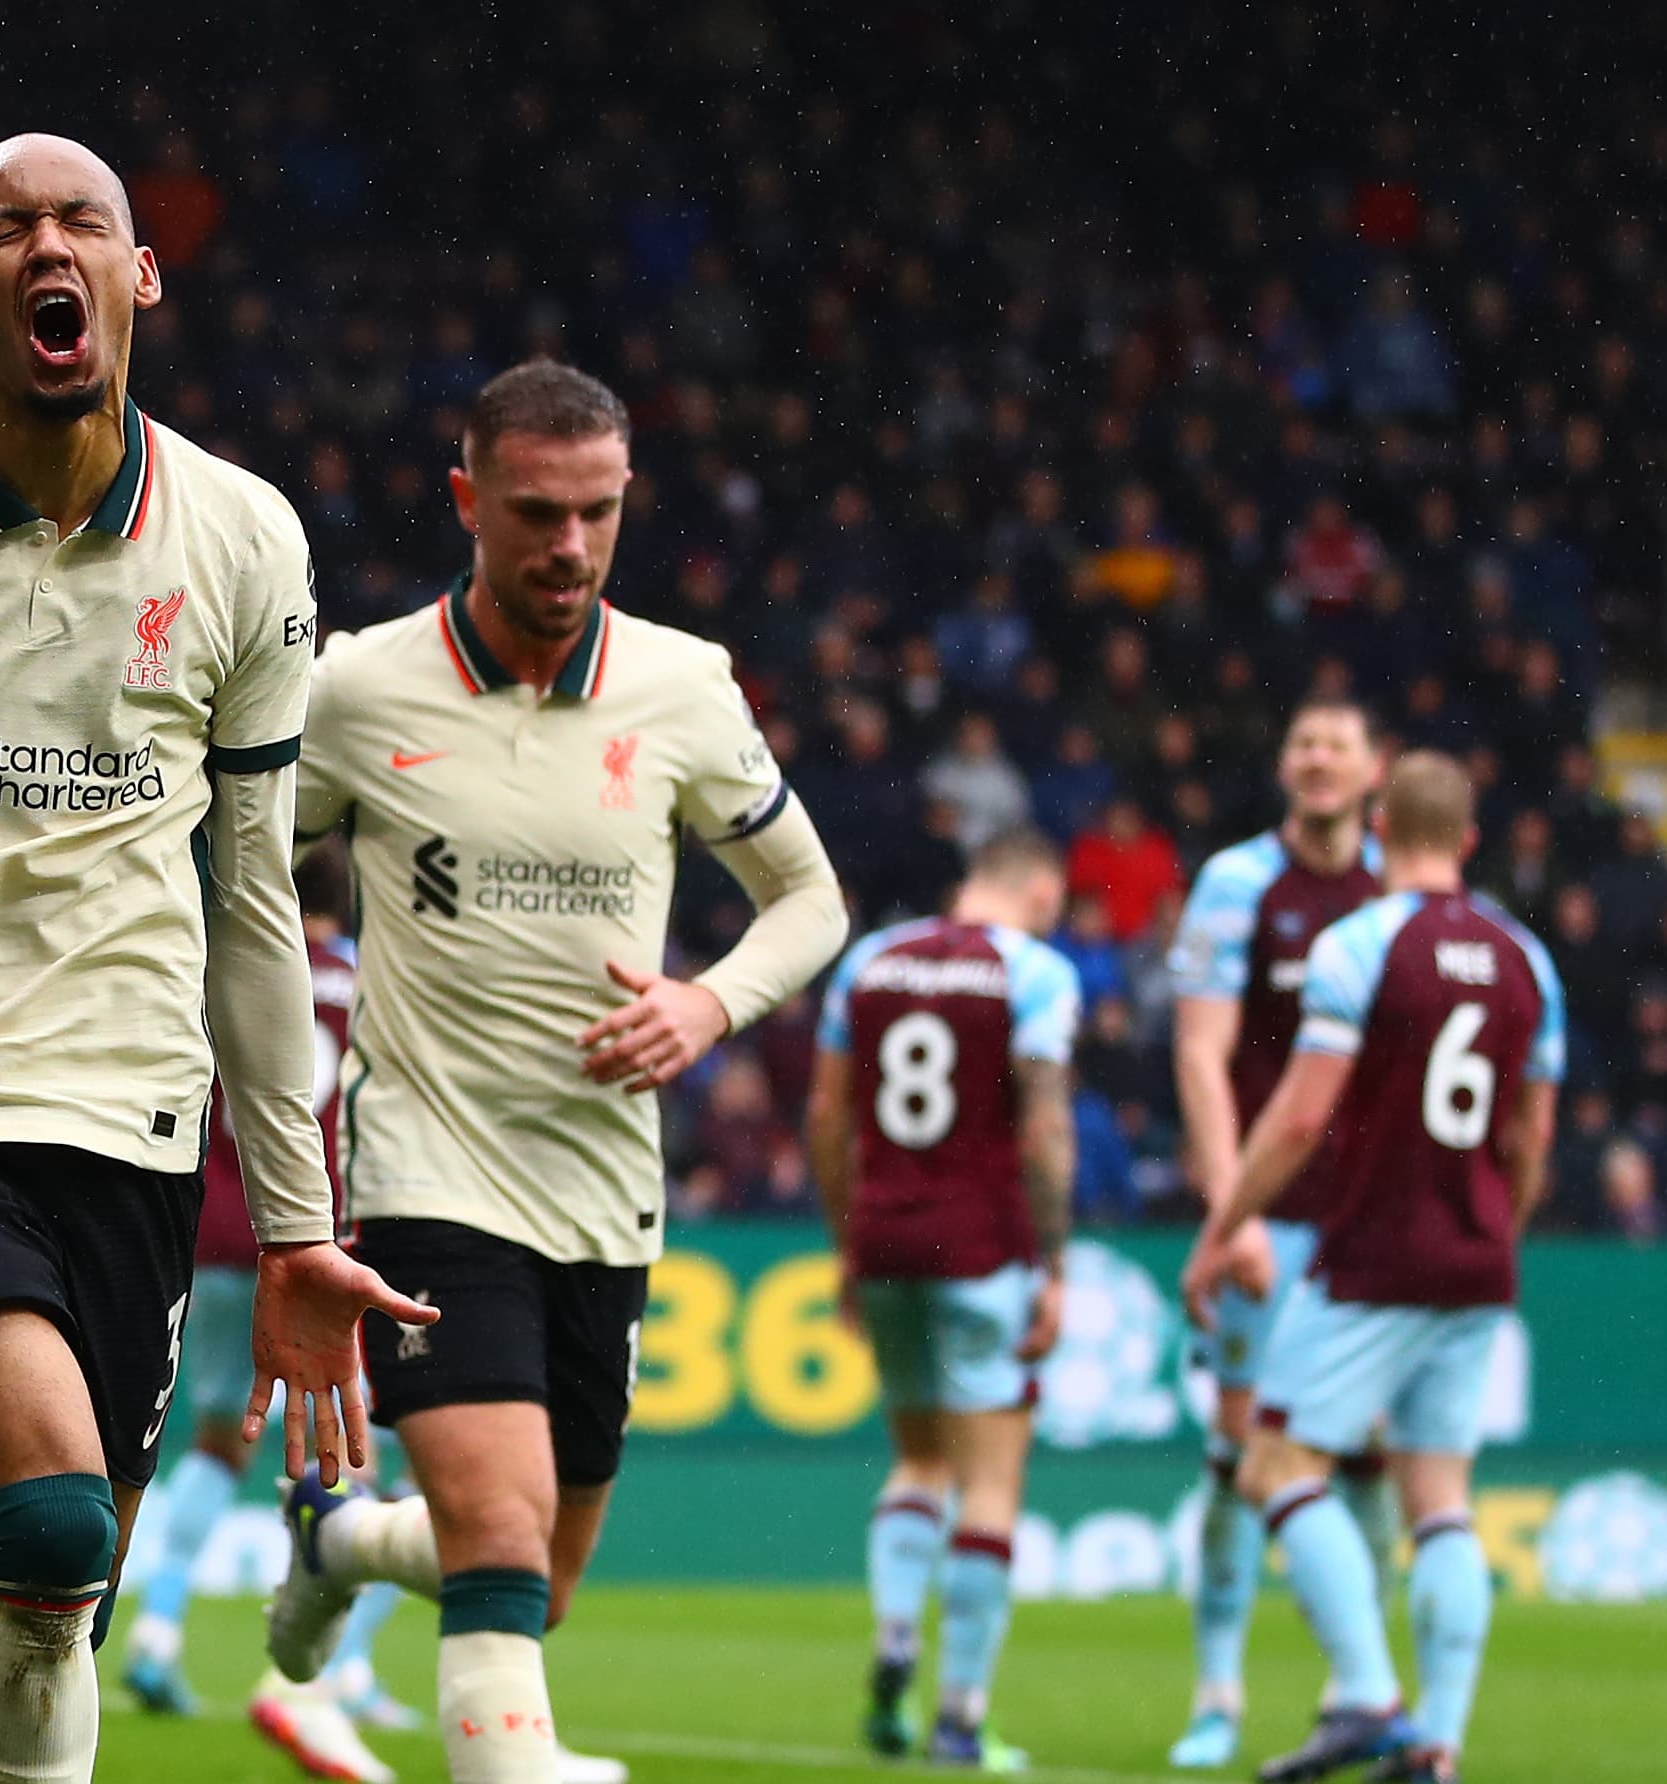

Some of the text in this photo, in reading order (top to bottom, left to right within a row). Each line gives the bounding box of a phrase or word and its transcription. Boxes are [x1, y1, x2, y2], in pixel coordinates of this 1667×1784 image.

[475, 884, 636, 918] chartered
[477, 852, 635, 888] standard
[874, 1010, 959, 1150] 8
[1421, 1001, 1497, 1150] 6
